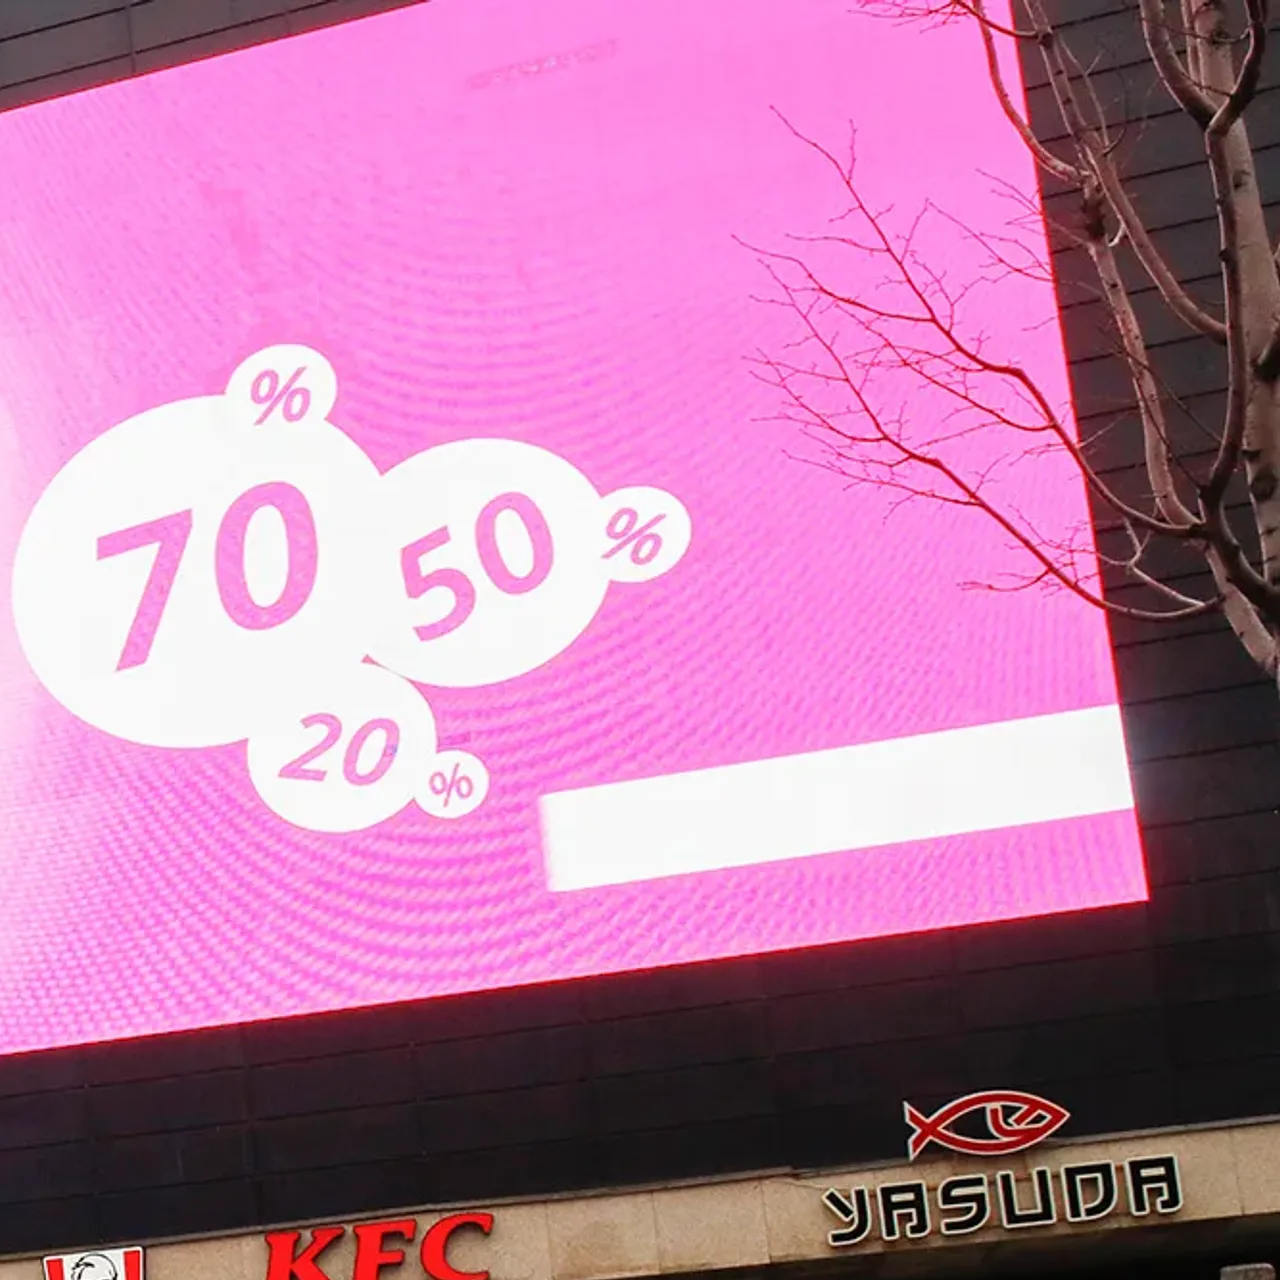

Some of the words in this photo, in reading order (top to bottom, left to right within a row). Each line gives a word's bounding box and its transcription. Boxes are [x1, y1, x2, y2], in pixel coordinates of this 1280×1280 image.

[96, 481, 318, 672] 70
[400, 491, 554, 642] 50
[278, 712, 401, 786] 20
[823, 1154, 1183, 1246] YASUDA
